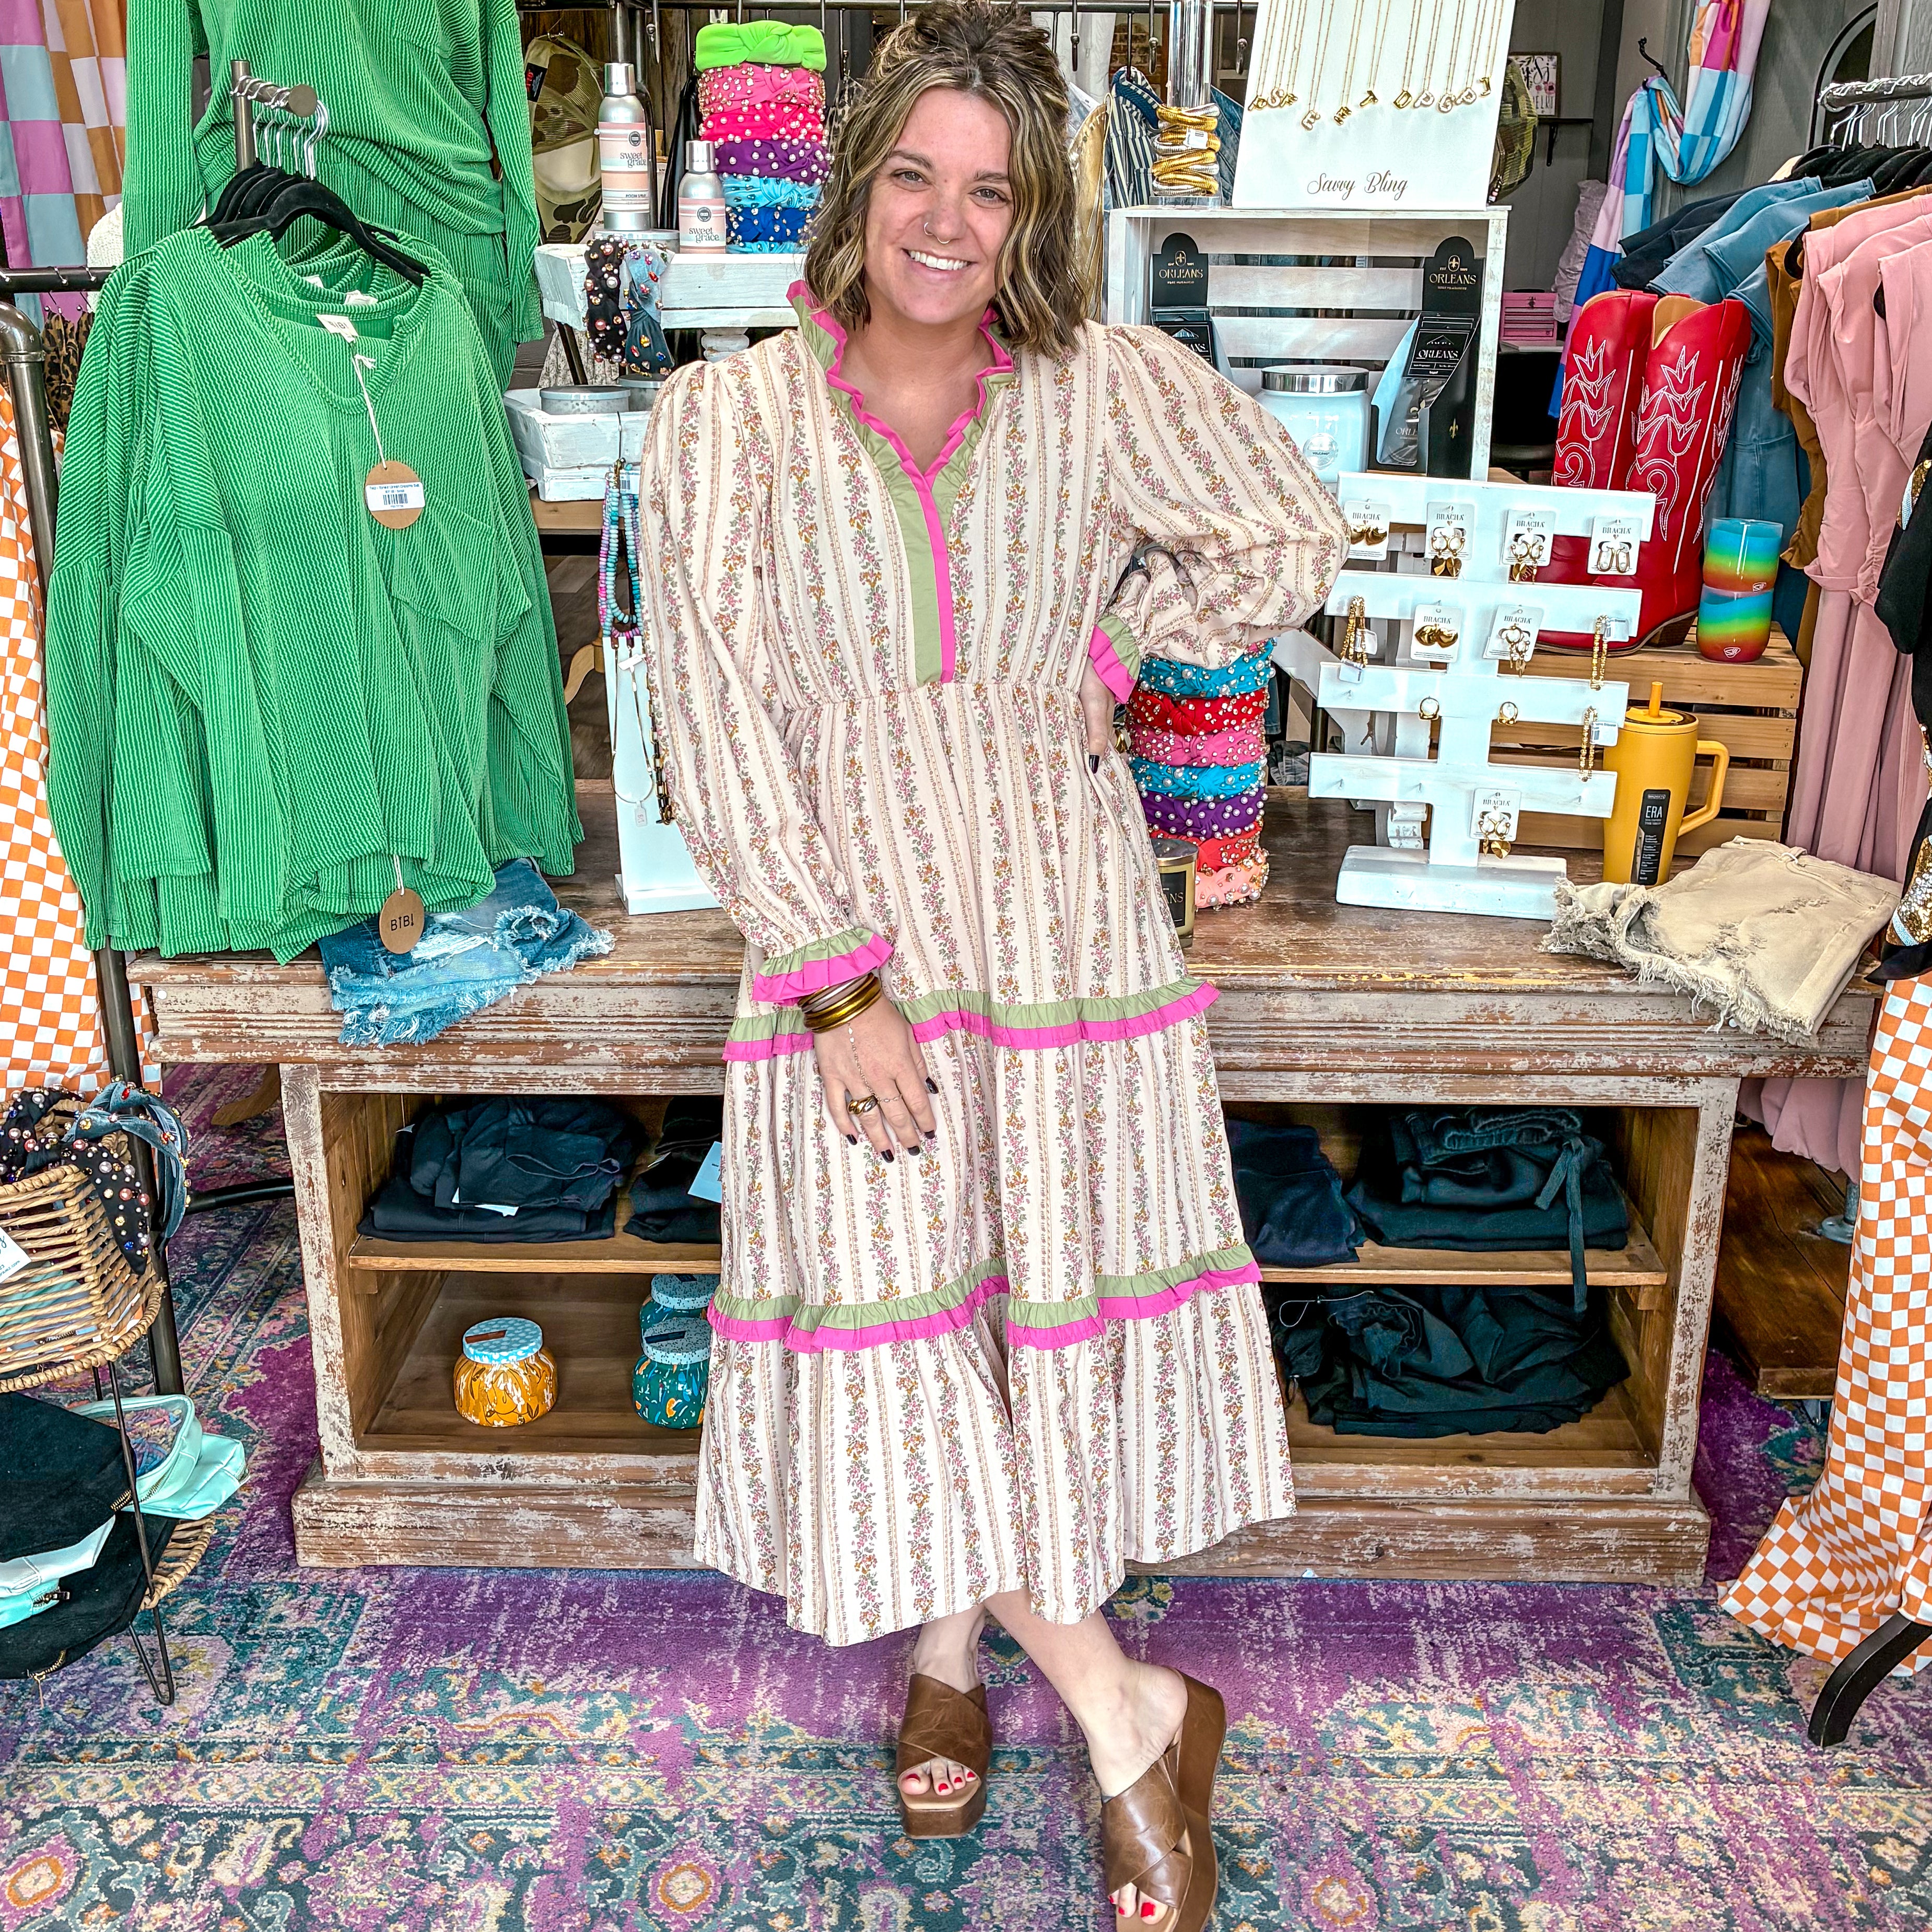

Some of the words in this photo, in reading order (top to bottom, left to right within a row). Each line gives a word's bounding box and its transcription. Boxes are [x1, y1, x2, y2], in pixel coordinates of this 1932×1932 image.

[627, 158, 647, 168] grace
[1307, 173, 1355, 201] Savvy
[1364, 170, 1408, 201] Bling
[695, 233, 720, 243] grace
[1159, 269, 1203, 278] ORLEANS
[1430, 273, 1477, 285] ORLEANS
[1419, 349, 1458, 358] ORLEANS
[1645, 806, 1662, 818] ERA
